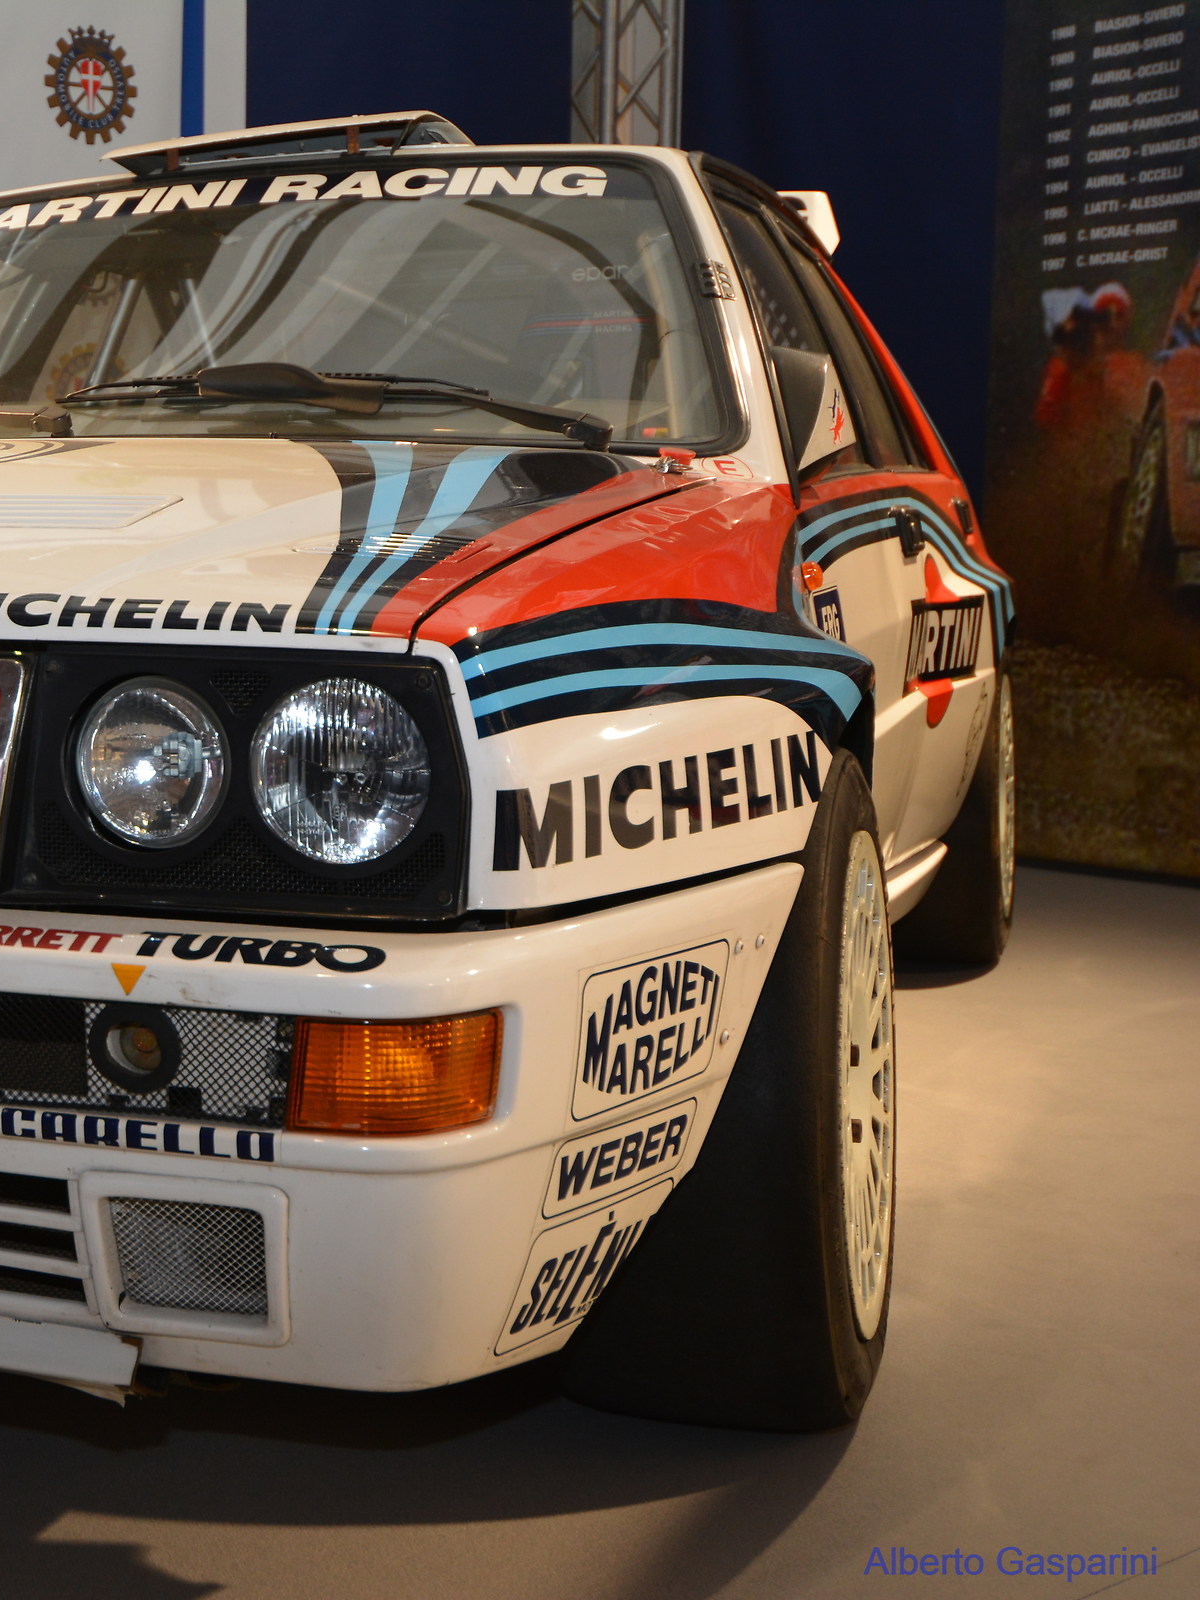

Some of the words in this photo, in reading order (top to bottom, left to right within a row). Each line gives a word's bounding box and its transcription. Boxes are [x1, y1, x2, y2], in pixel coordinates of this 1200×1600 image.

[1094, 6, 1185, 33] BIASION-SIVIERO
[1050, 51, 1075, 66] 1989
[1093, 33, 1184, 60] BIASION-SIVIERO
[1049, 77, 1074, 92] 1990
[1091, 58, 1181, 86] AURIOL-OCCELLI
[1048, 103, 1072, 118] 1991
[1089, 86, 1180, 112] AURIOL-OCCELLI
[1047, 129, 1071, 144] 1992
[1088, 109, 1200, 138] AGHINI-FARNOCCHIA
[1046, 155, 1070, 169] 1993
[1087, 146, 1130, 164] CUNICO
[259, 165, 608, 203] RACING
[1045, 181, 1068, 195] 1994
[1085, 172, 1127, 190] AURIOL
[1139, 166, 1184, 183] OCCELLI
[1084, 199, 1119, 216] LIATTI
[1090, 219, 1178, 240] MCRAE-RINGER
[1042, 258, 1065, 272] 1997
[1089, 247, 1169, 266] MCRAE-GRIST
[492, 730, 823, 871] MICHELIN
[135, 930, 386, 973] TURBO
[1, 1107, 275, 1162] CARELLO
[557, 1114, 688, 1201] WEBER
